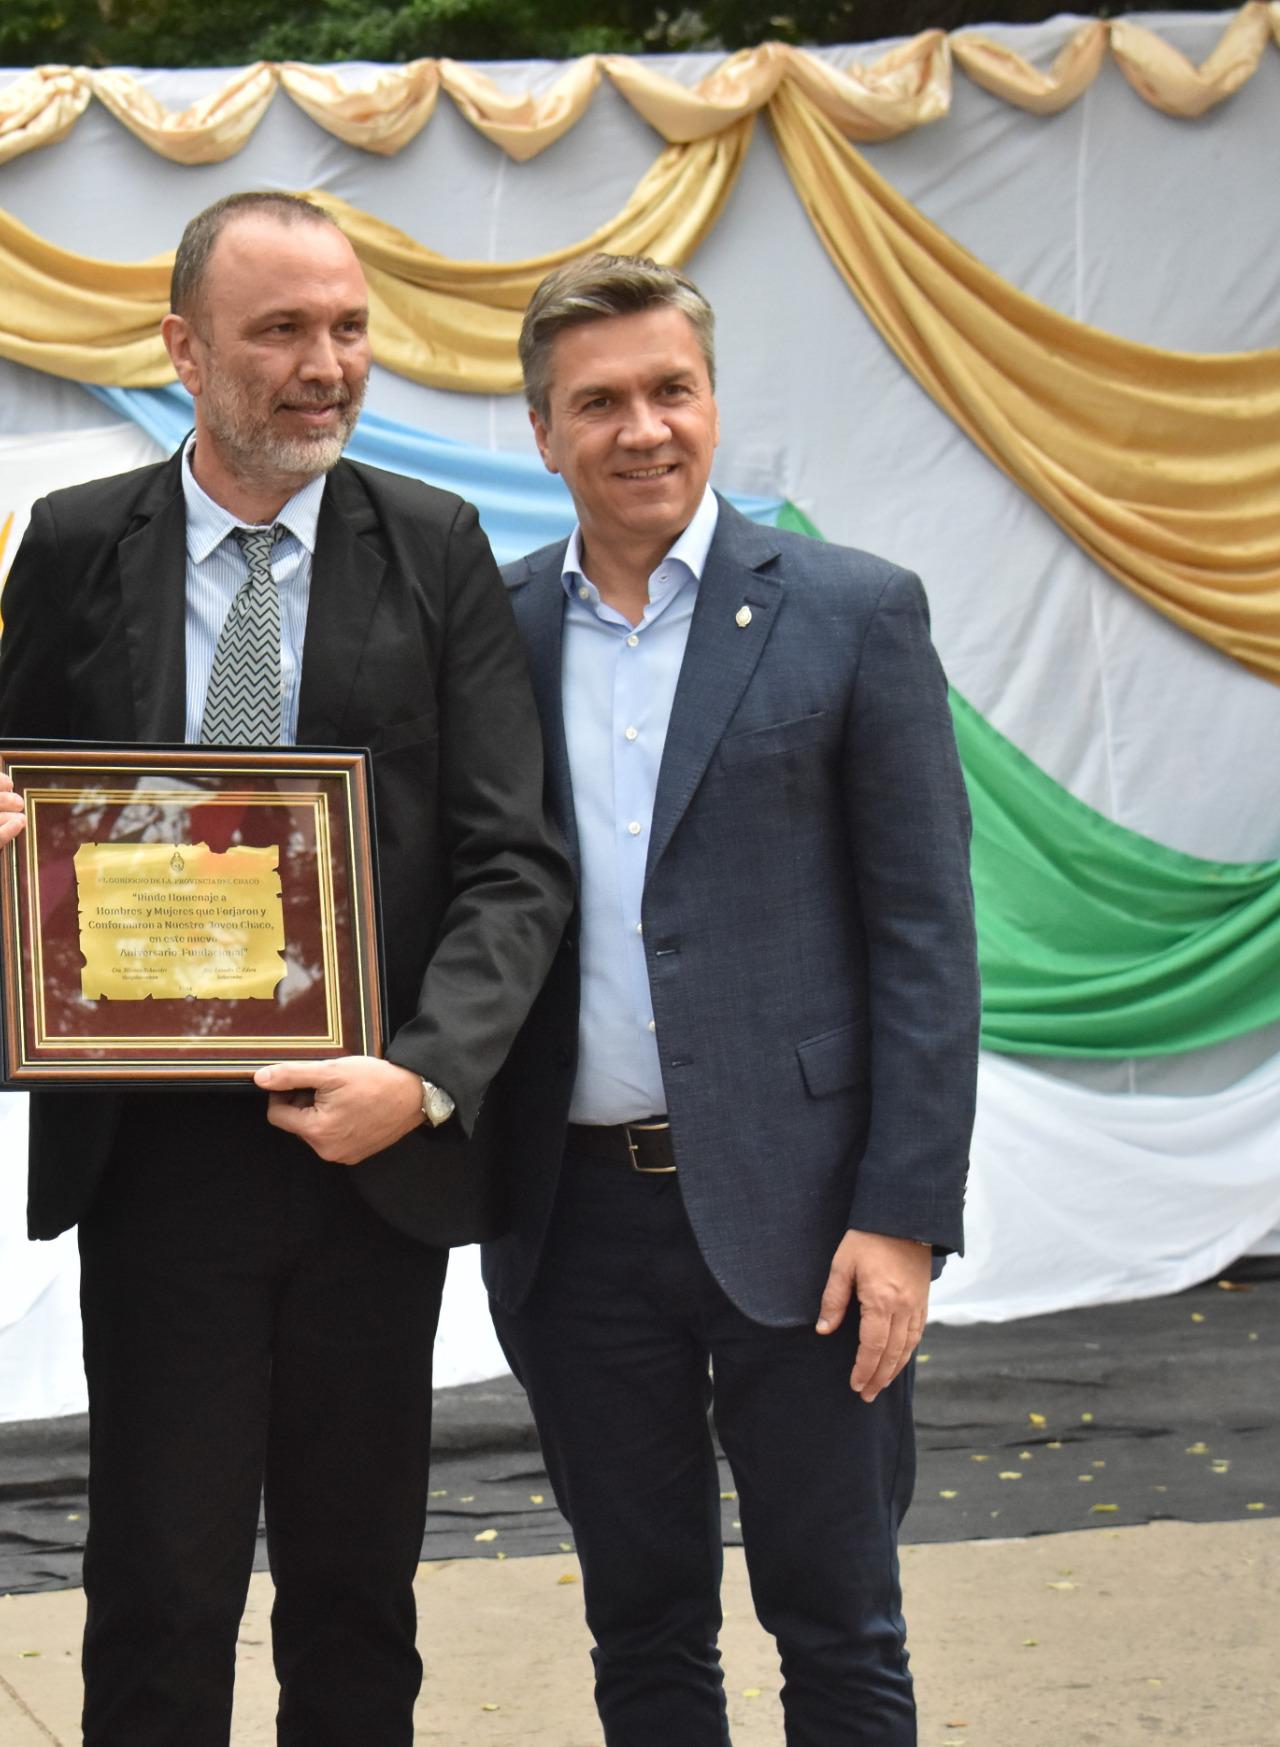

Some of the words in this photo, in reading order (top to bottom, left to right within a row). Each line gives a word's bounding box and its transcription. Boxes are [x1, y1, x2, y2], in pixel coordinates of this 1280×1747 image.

[168, 892, 219, 904] Homenaje
[96, 906, 143, 916] Hombres
[146, 908, 153, 917] y
[154, 907, 194, 917] Mujeres
[195, 909, 215, 917] que
[260, 909, 267, 918] y
[88, 920, 155, 930] Conformaron
[165, 920, 205, 930] Nuestro
[240, 921, 275, 931] Chaco,
[163, 935, 186, 943] este
[120, 948, 178, 957] Aniversario
